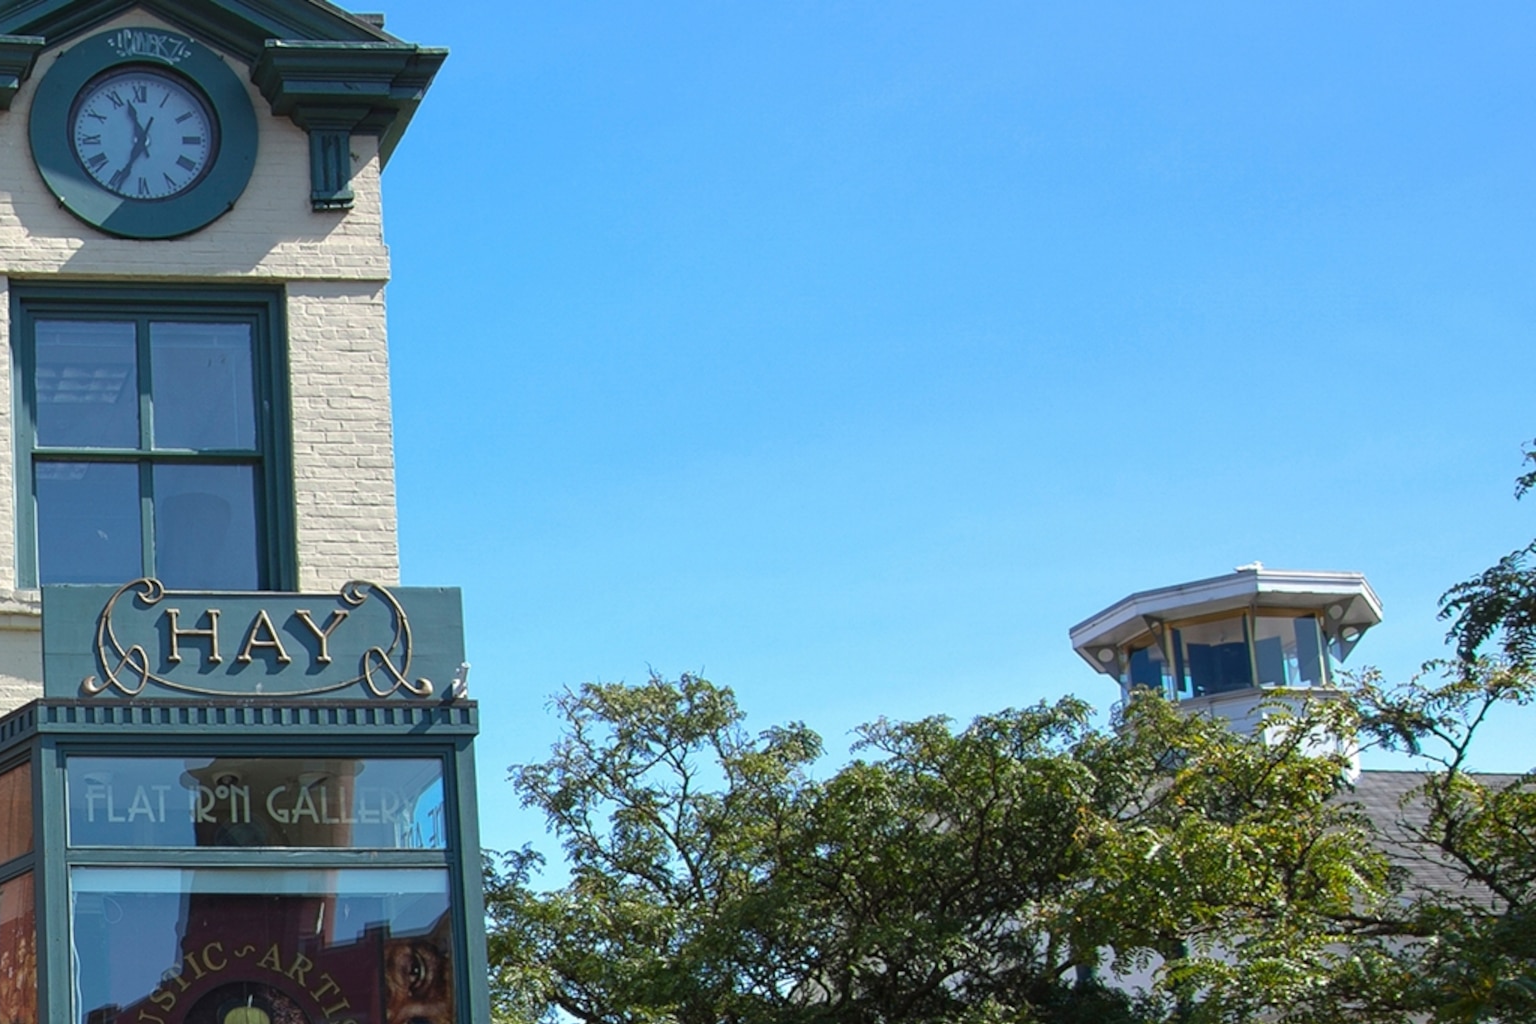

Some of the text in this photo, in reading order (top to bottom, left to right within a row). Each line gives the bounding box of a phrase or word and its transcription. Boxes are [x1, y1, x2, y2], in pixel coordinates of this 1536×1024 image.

[165, 608, 349, 663] HAY
[85, 784, 171, 823] FLAT
[265, 785, 413, 826] GALLERY
